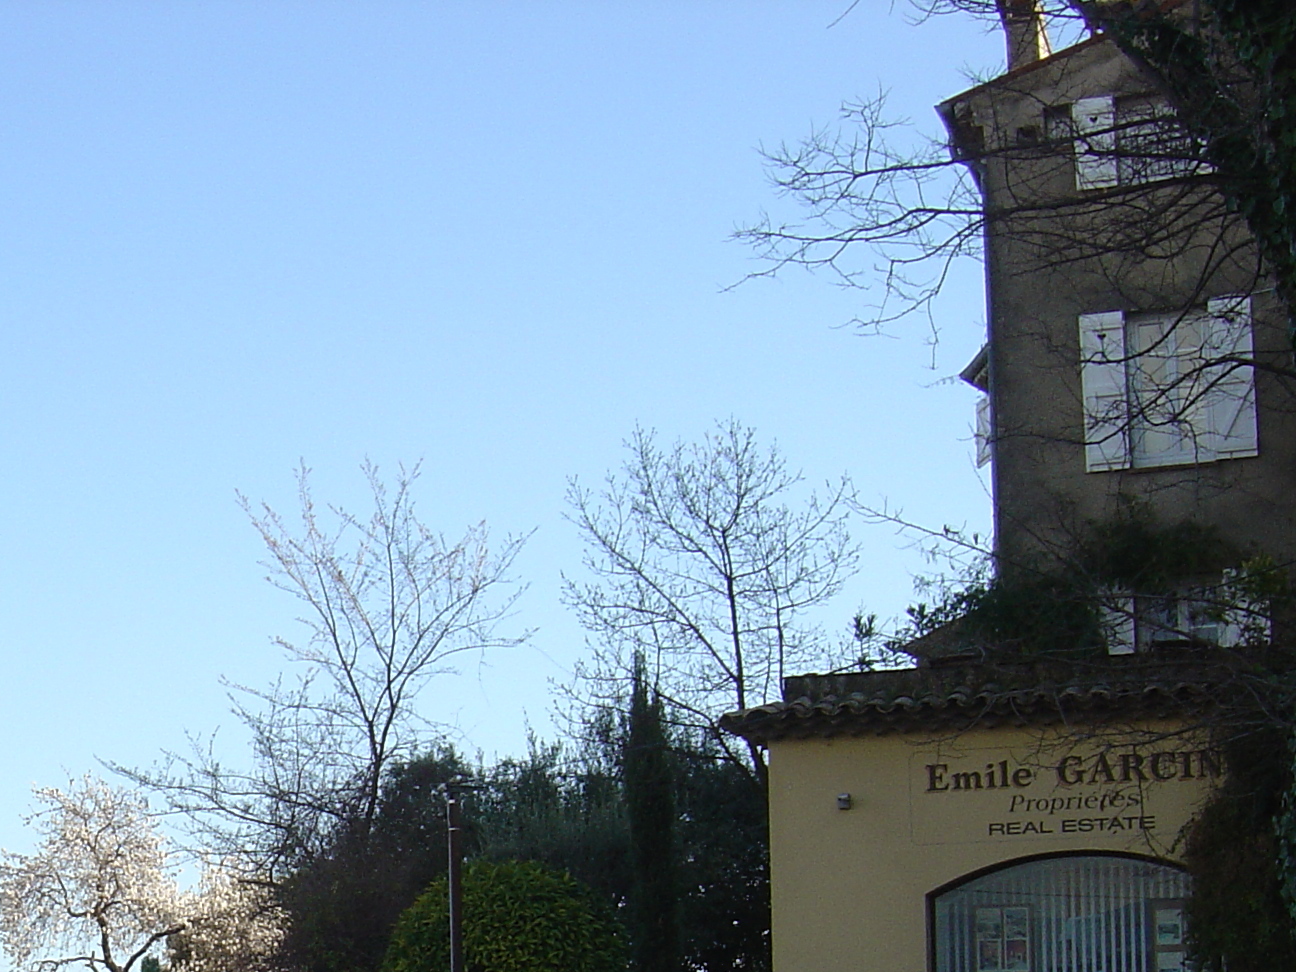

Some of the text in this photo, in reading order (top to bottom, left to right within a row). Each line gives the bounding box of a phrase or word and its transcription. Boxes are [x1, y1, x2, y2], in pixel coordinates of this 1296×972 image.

[925, 760, 1034, 793] Emile
[988, 815, 1157, 836] REAL ESTATE
